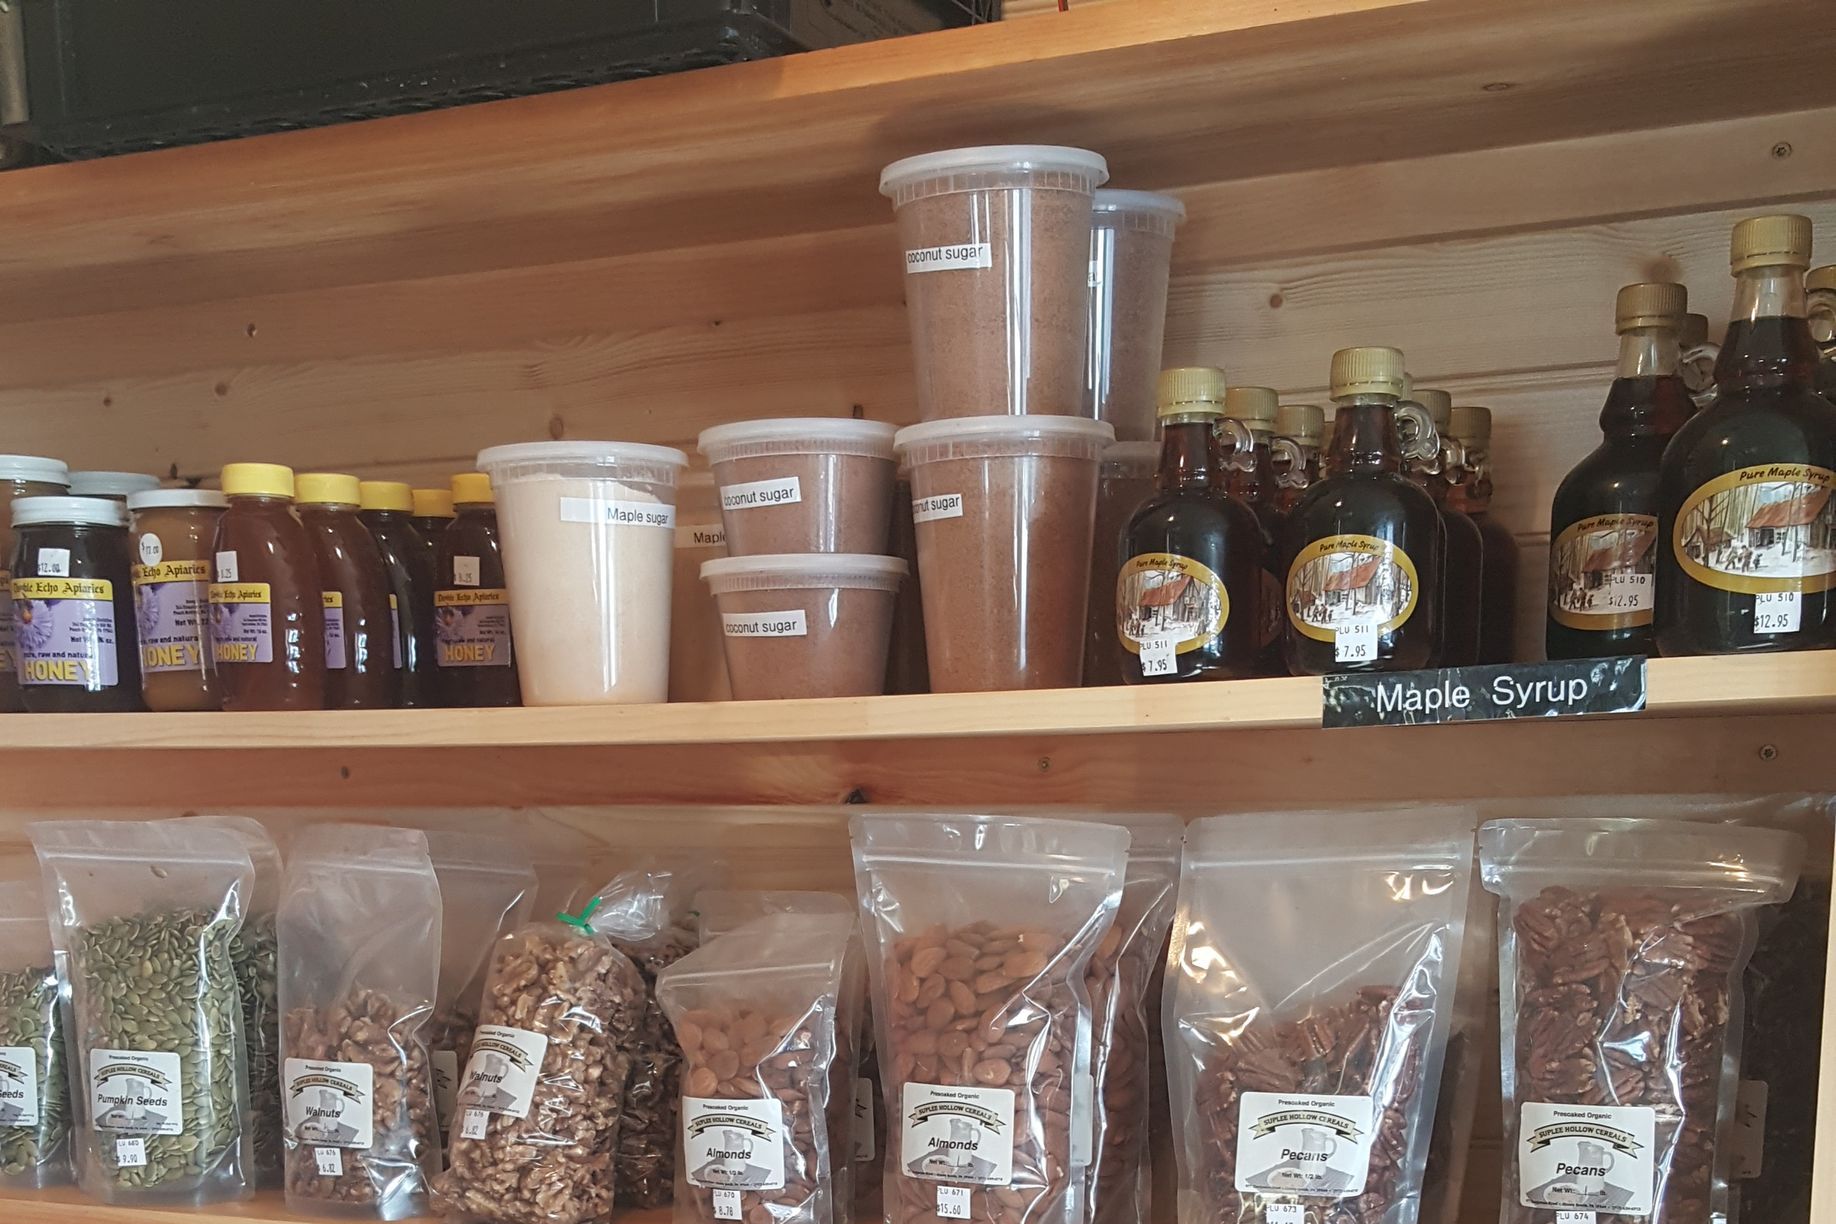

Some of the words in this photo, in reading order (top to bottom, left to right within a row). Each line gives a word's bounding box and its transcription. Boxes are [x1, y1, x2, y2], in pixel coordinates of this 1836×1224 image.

[908, 248, 942, 263] coconut
[946, 247, 983, 260] sugar
[1739, 470, 1765, 481] Pure
[1767, 468, 1800, 477] Maple
[1802, 468, 1830, 483] Syrup
[724, 494, 757, 507] coconut
[760, 487, 794, 503] sugar
[931, 496, 960, 511] sugar
[607, 507, 643, 522] Maple
[646, 512, 668, 526] sugar
[1577, 522, 1595, 531] Pure
[1626, 519, 1654, 527] Syrup
[1320, 543, 1334, 552] Pure
[1336, 540, 1358, 549] Maple
[165, 564, 206, 578] Apiaries
[1150, 559, 1167, 567] Maple
[1169, 561, 1188, 570] Syrup
[1629, 576, 1645, 584] 510
[36, 582, 58, 595] Echo
[62, 582, 104, 595] Apiaries
[238, 590, 262, 600] Apiaries
[1609, 595, 1638, 607] $12.95
[1778, 594, 1794, 602] 510
[726, 621, 759, 634] coconut
[762, 619, 798, 633] sugar
[1754, 614, 1788, 628] $12.95
[1355, 625, 1369, 633] 511
[216, 643, 258, 660] HONEY
[444, 644, 495, 662] HONEY
[24, 660, 92, 682] HONEY
[1376, 681, 1470, 714] Maple
[1492, 675, 1588, 711] Syrup
[500, 1044, 522, 1057] CEREALS
[138, 1067, 160, 1079] CEREALS
[471, 1072, 503, 1083] Walnuts
[330, 1080, 352, 1090] CEREALS
[97, 1094, 133, 1106] Pumpkin
[136, 1096, 167, 1107] Seeds
[1311, 1100, 1335, 1108] Organic
[305, 1106, 340, 1118] Walnuts
[939, 1104, 964, 1113] HOLLOW
[965, 1106, 993, 1120] CEREALS
[1587, 1111, 1612, 1120] Organic
[736, 1119, 762, 1130] CEREALS
[1263, 1115, 1288, 1126] SUPLEE
[1289, 1114, 1317, 1122] HOLLOW
[1538, 1126, 1564, 1138] SUPLEE
[1565, 1126, 1593, 1134] HOLLOW
[1595, 1127, 1627, 1143] CEREALS
[927, 1137, 978, 1151] Almonds
[706, 1147, 751, 1160] Almonds
[1280, 1149, 1328, 1162] Pecans
[1556, 1163, 1607, 1177] Pecans
[723, 1191, 734, 1199] 670
[937, 1202, 961, 1215] $15.60
[1574, 1212, 1588, 1221] 674
